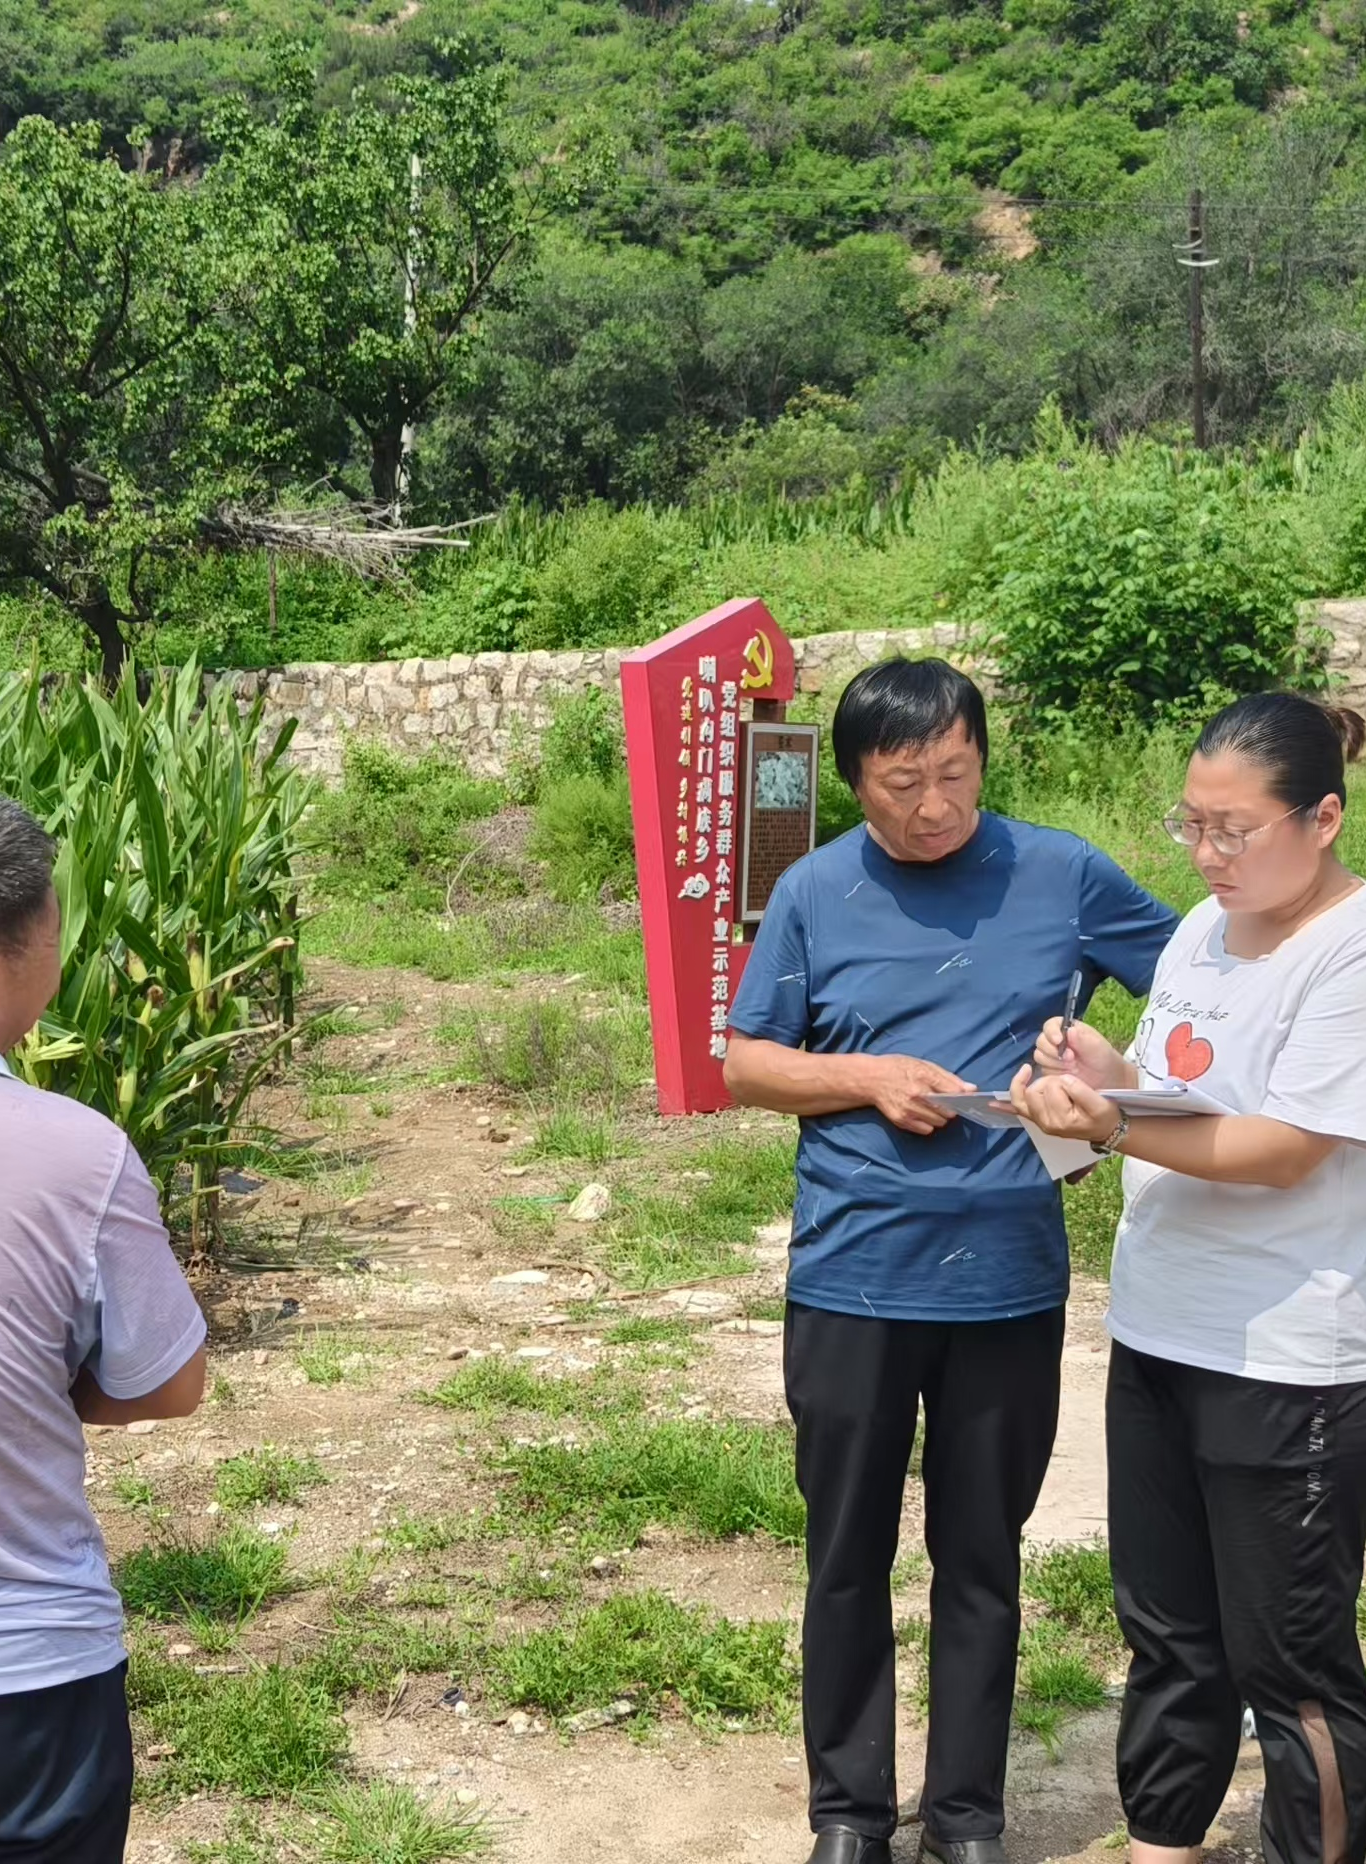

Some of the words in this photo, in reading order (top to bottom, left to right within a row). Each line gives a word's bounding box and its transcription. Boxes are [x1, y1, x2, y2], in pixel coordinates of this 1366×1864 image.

[709, 680, 737, 1060] 党组织服务群众产业示范基地
